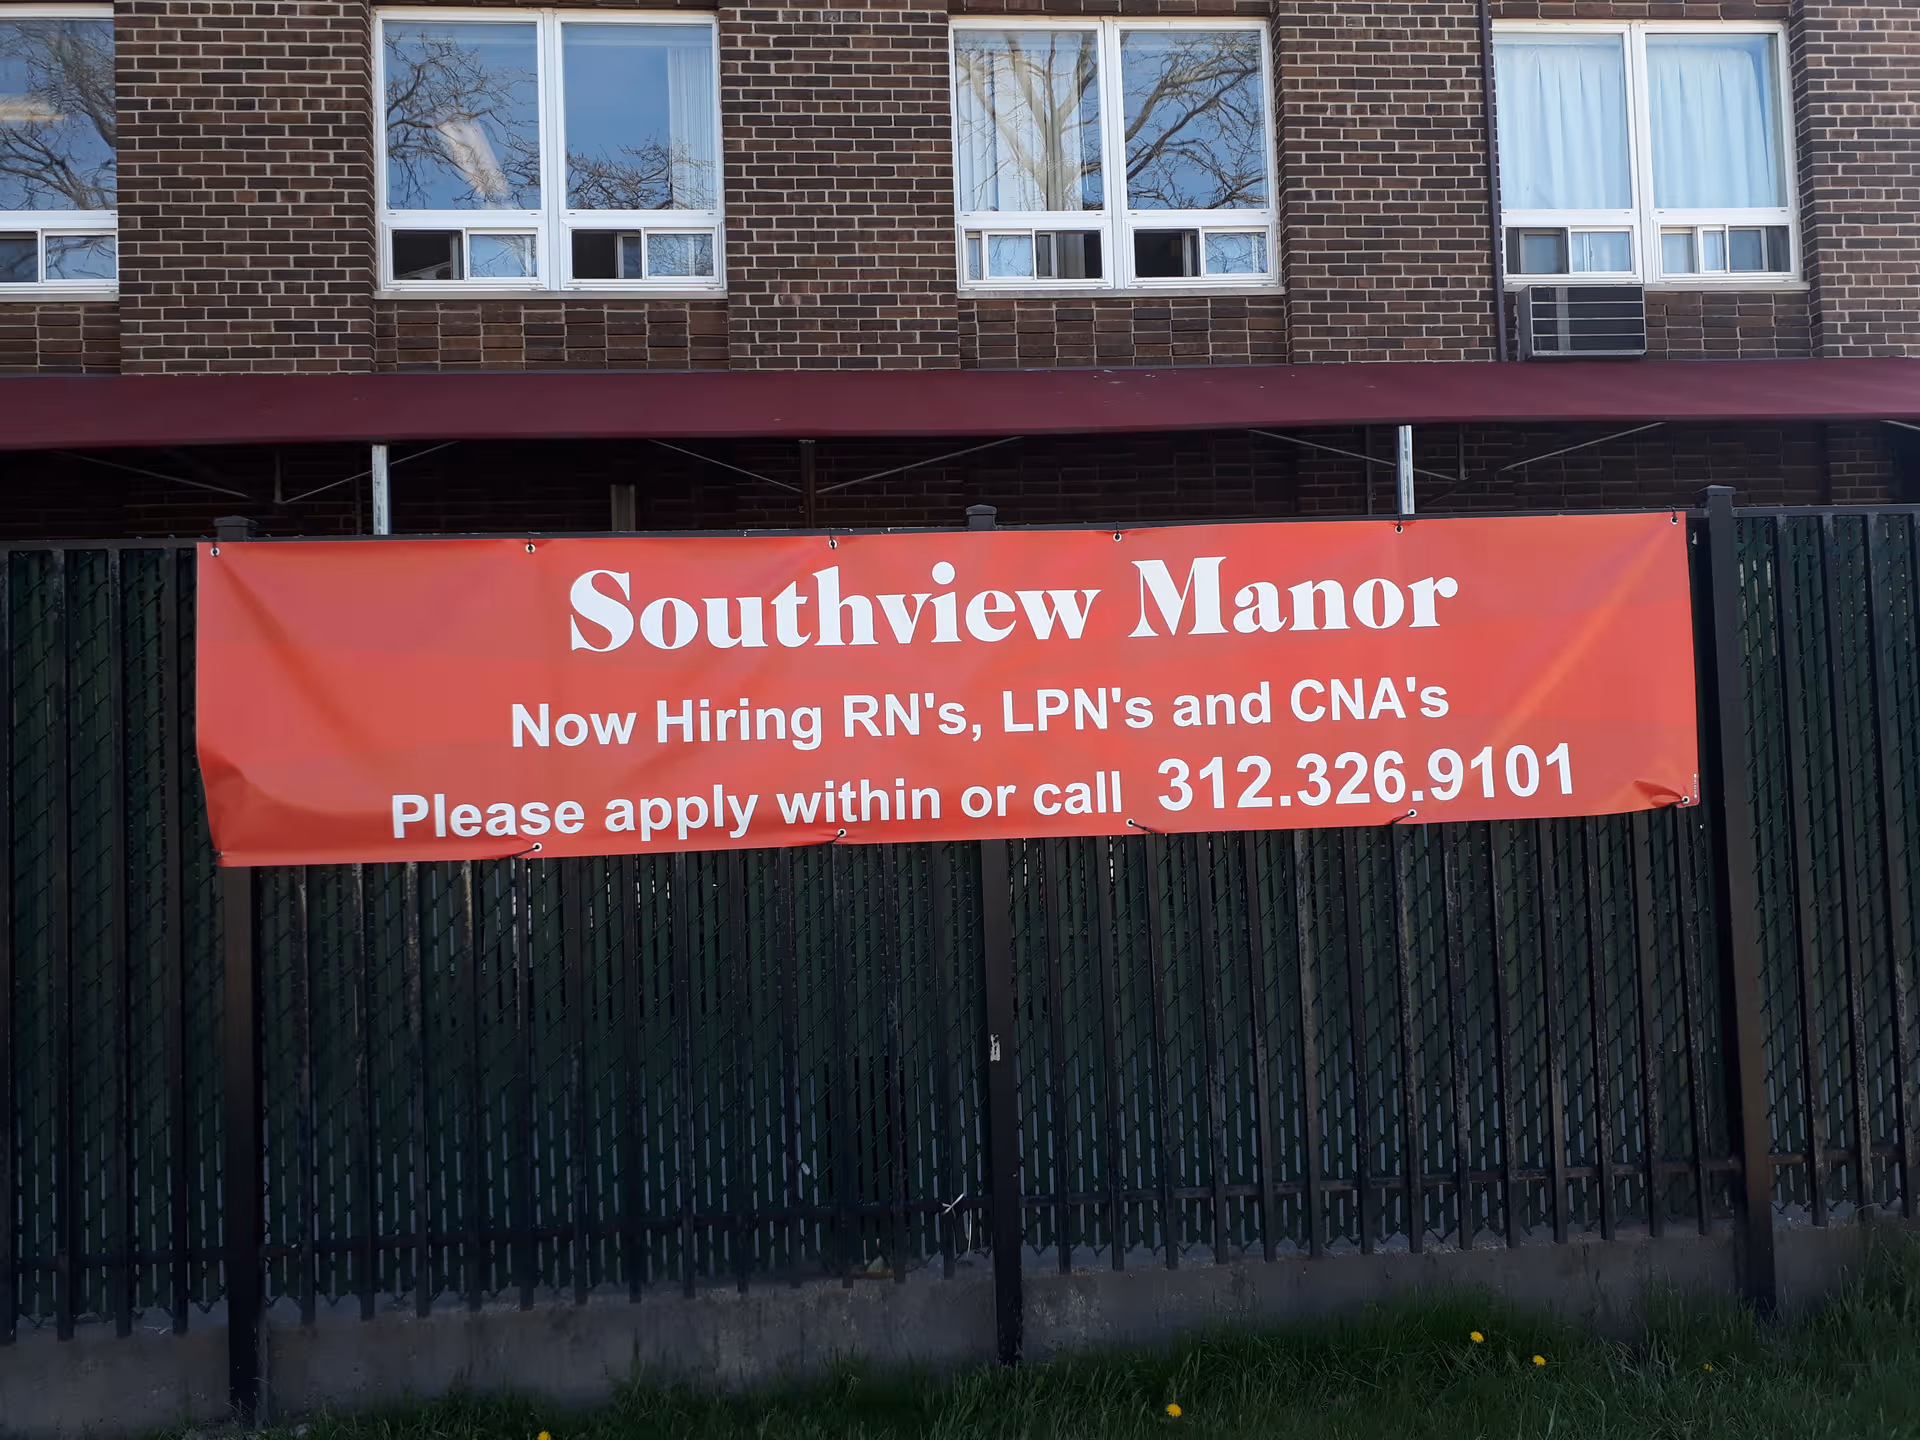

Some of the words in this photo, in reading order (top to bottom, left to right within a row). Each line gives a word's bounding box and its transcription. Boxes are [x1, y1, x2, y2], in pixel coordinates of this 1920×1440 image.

[569, 562, 1101, 653] Southview
[1127, 556, 1459, 638] Manor
[511, 703, 637, 748] Now
[656, 697, 822, 751] Hiring
[843, 692, 983, 742] RN's,
[1002, 686, 1154, 733] LPN's
[1173, 680, 1271, 727] and
[1290, 676, 1449, 723] CNA's
[392, 793, 585, 839] Please
[604, 784, 759, 842] apply
[775, 777, 941, 825] within
[960, 784, 1017, 818] or
[1033, 770, 1122, 816] call
[1157, 743, 1573, 812] 312.326.9101
